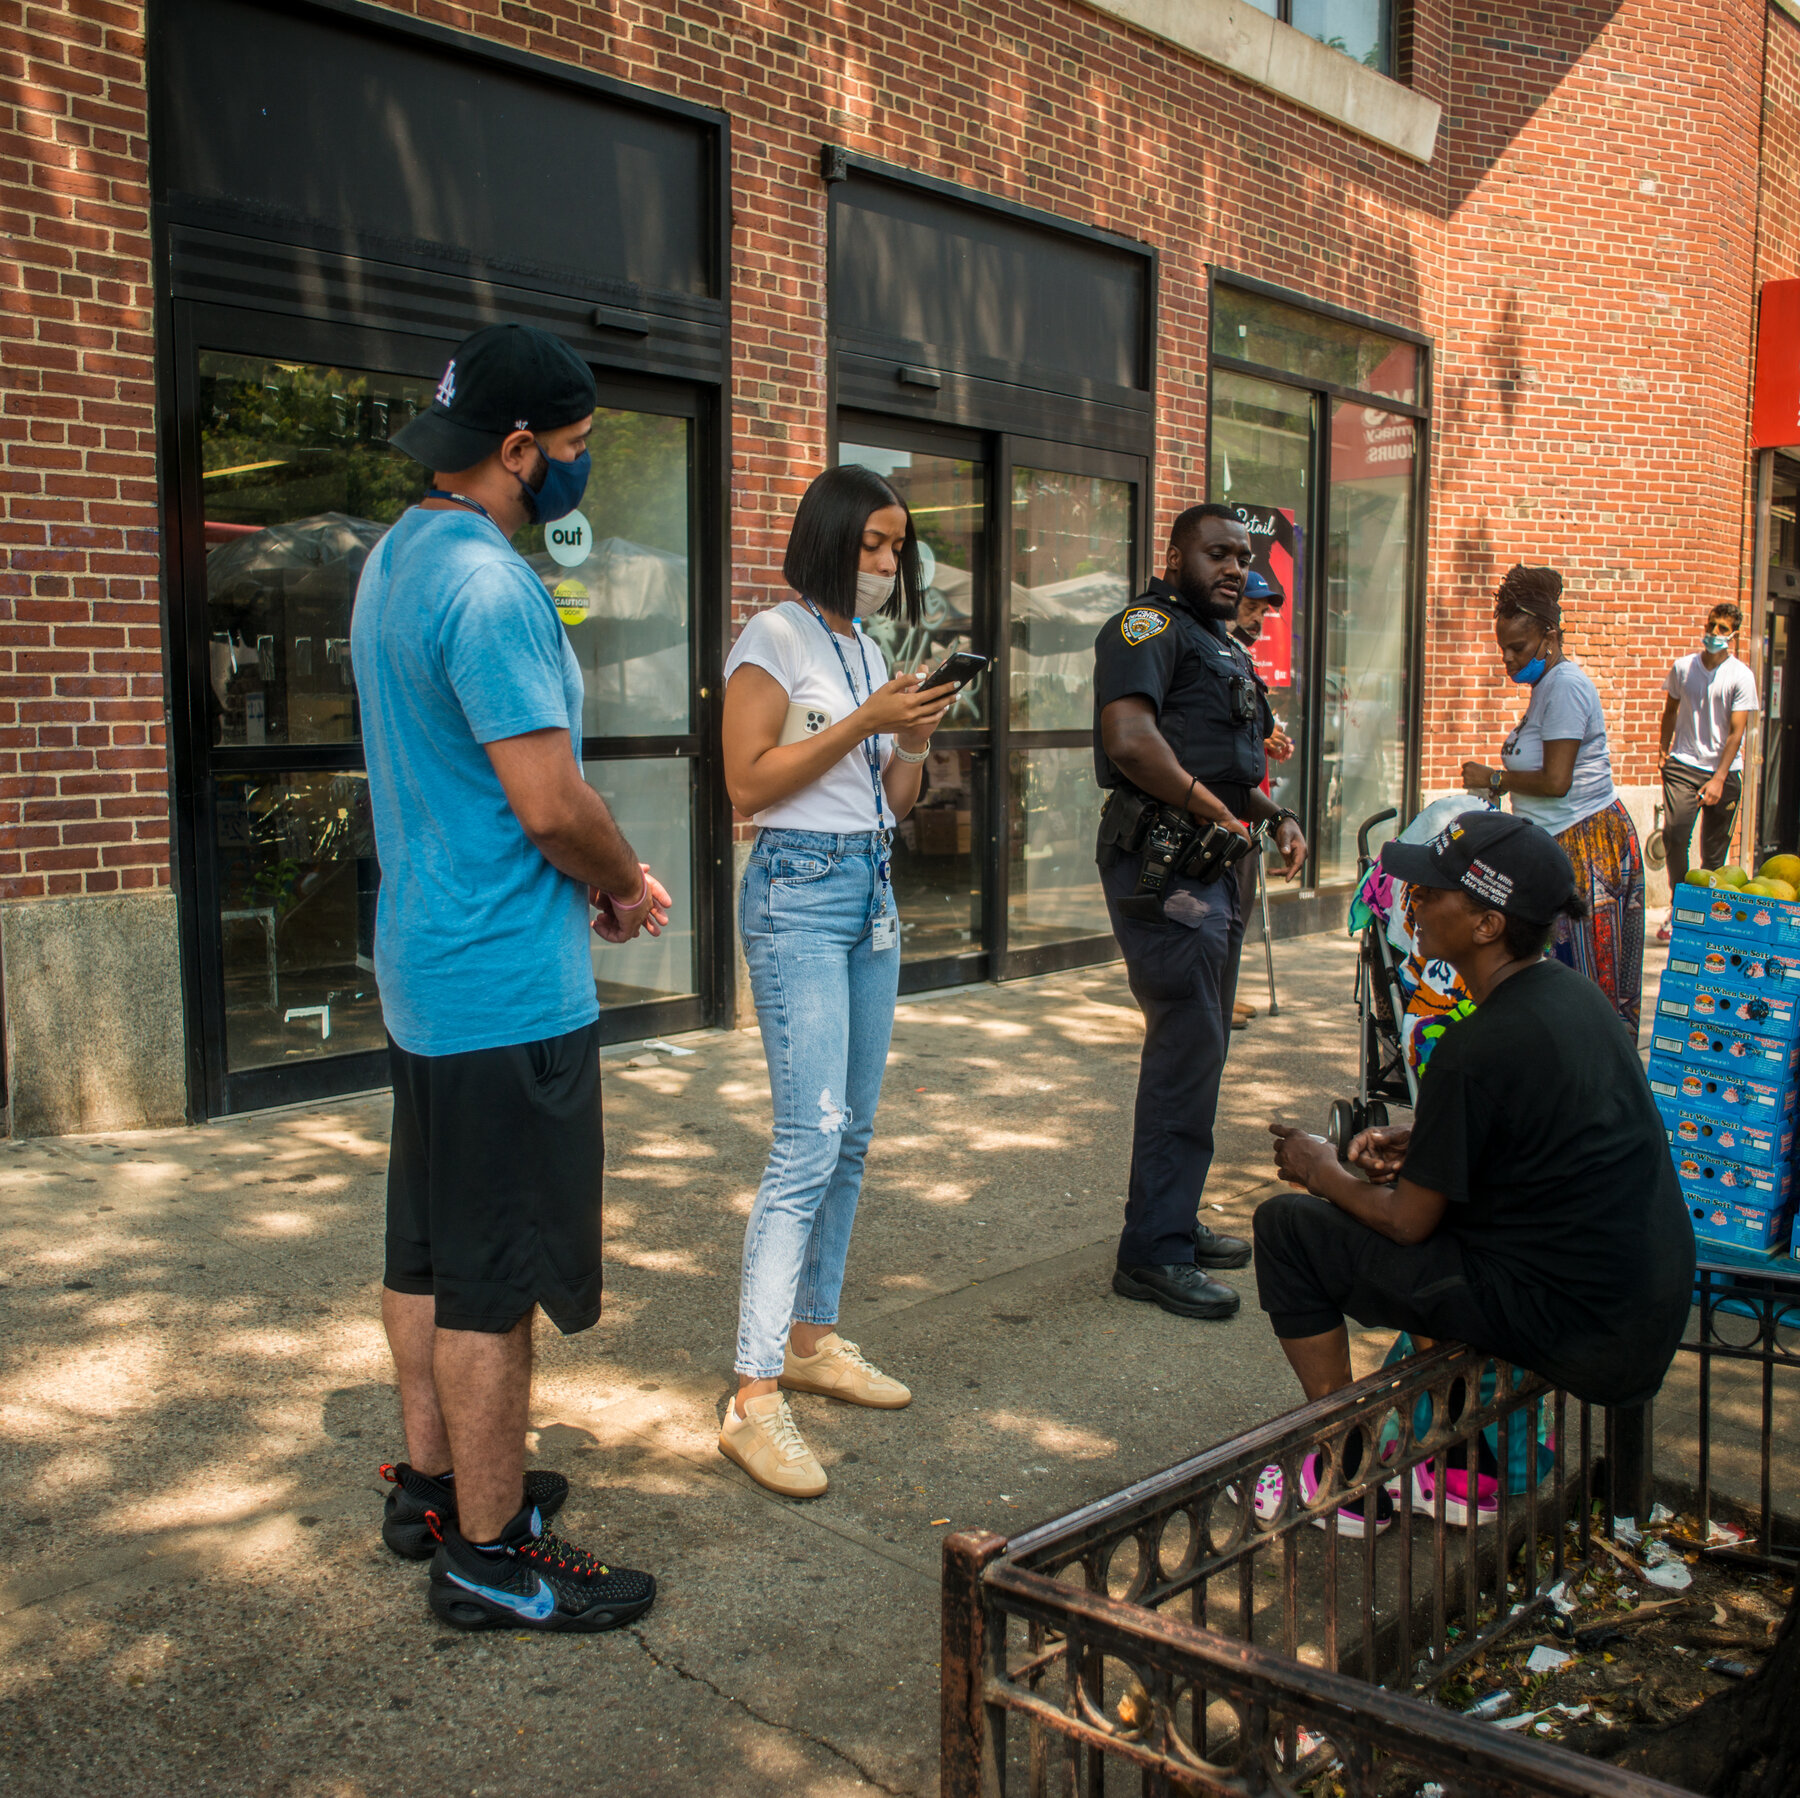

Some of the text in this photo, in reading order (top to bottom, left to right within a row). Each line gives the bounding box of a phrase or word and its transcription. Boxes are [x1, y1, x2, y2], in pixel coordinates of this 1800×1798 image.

[436, 360, 456, 408] LA
[552, 526, 582, 546] out
[554, 598, 589, 606] CAUTION
[1473, 858, 1496, 877] Working
[1466, 870, 1508, 899] transportation
[1712, 890, 1726, 900] Eat
[1728, 894, 1754, 905] When
[1756, 898, 1776, 908] Soft
[1706, 942, 1770, 960] Eat When Soft
[1695, 983, 1760, 1001] Eat When Soft
[1689, 1021, 1751, 1040] Eat When Soft
[1683, 1065, 1744, 1086] Eat When Soft
[1679, 1110, 1740, 1130] Eat When Soft
[1680, 1150, 1741, 1170] Eat When Soft
[1687, 1192, 1731, 1209] When Soft
